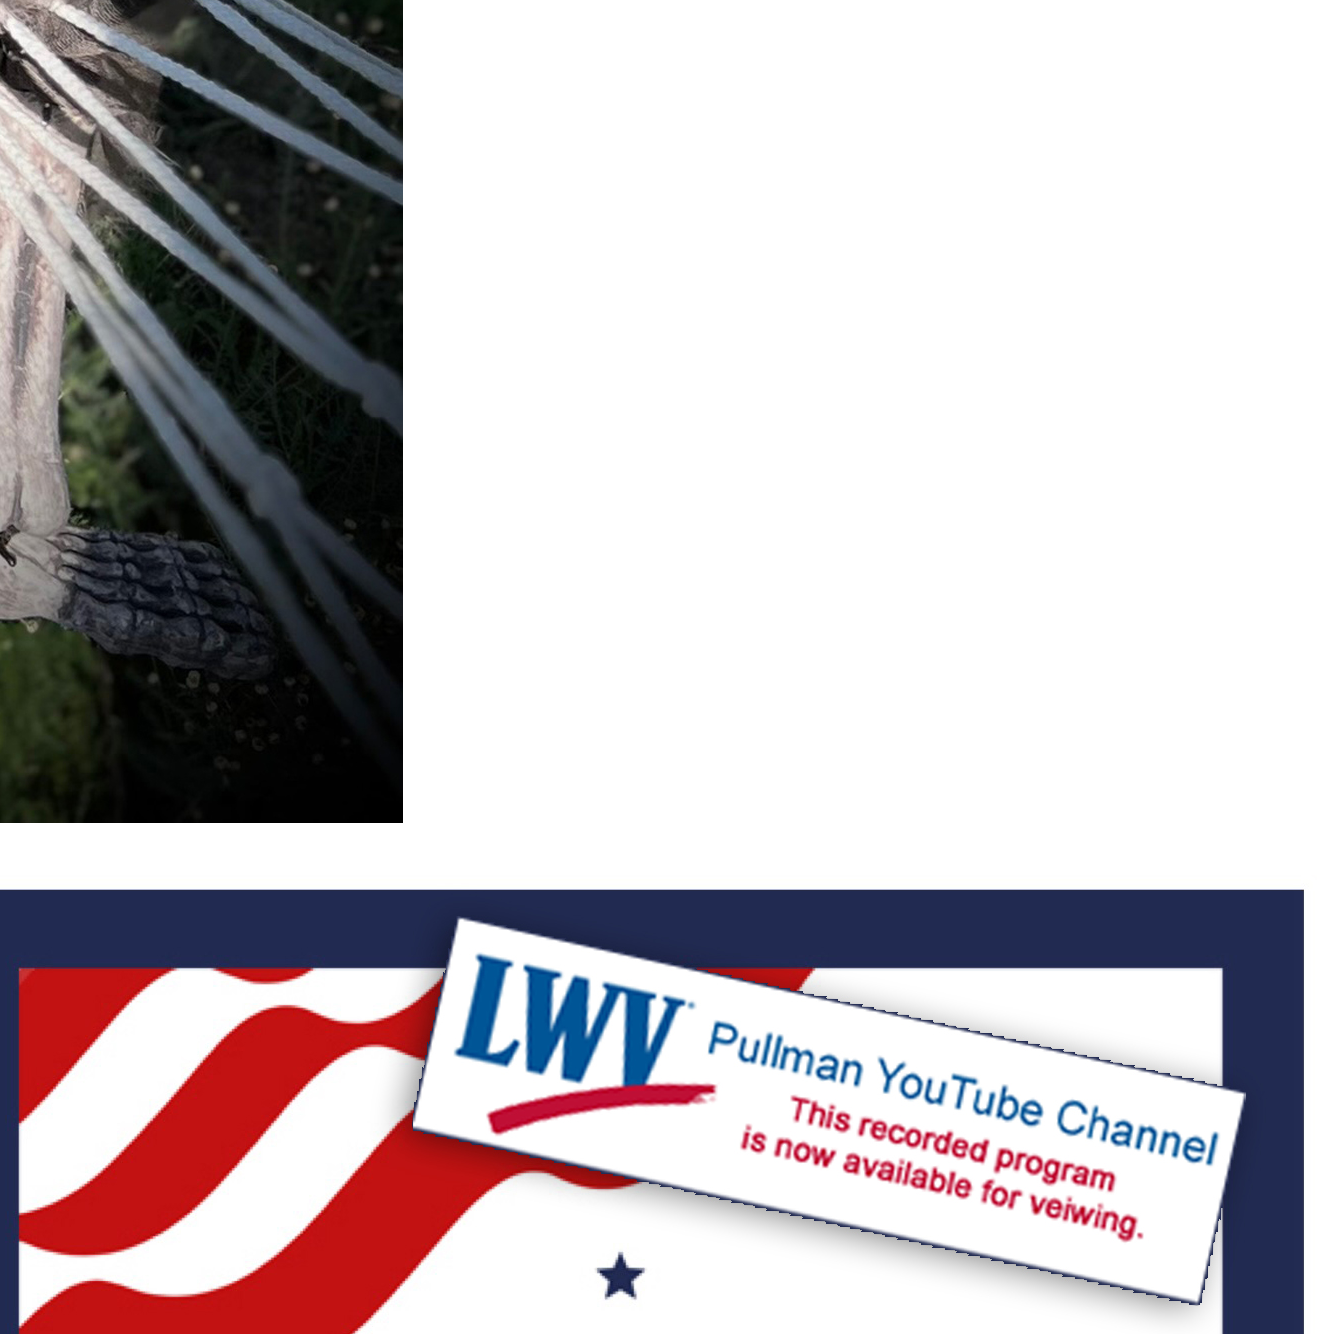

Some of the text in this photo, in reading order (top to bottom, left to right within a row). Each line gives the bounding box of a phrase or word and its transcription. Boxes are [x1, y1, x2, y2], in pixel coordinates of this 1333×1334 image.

[455, 955, 685, 1085] LWV
[709, 1022, 1218, 1165] Pullman YouTube Channel
